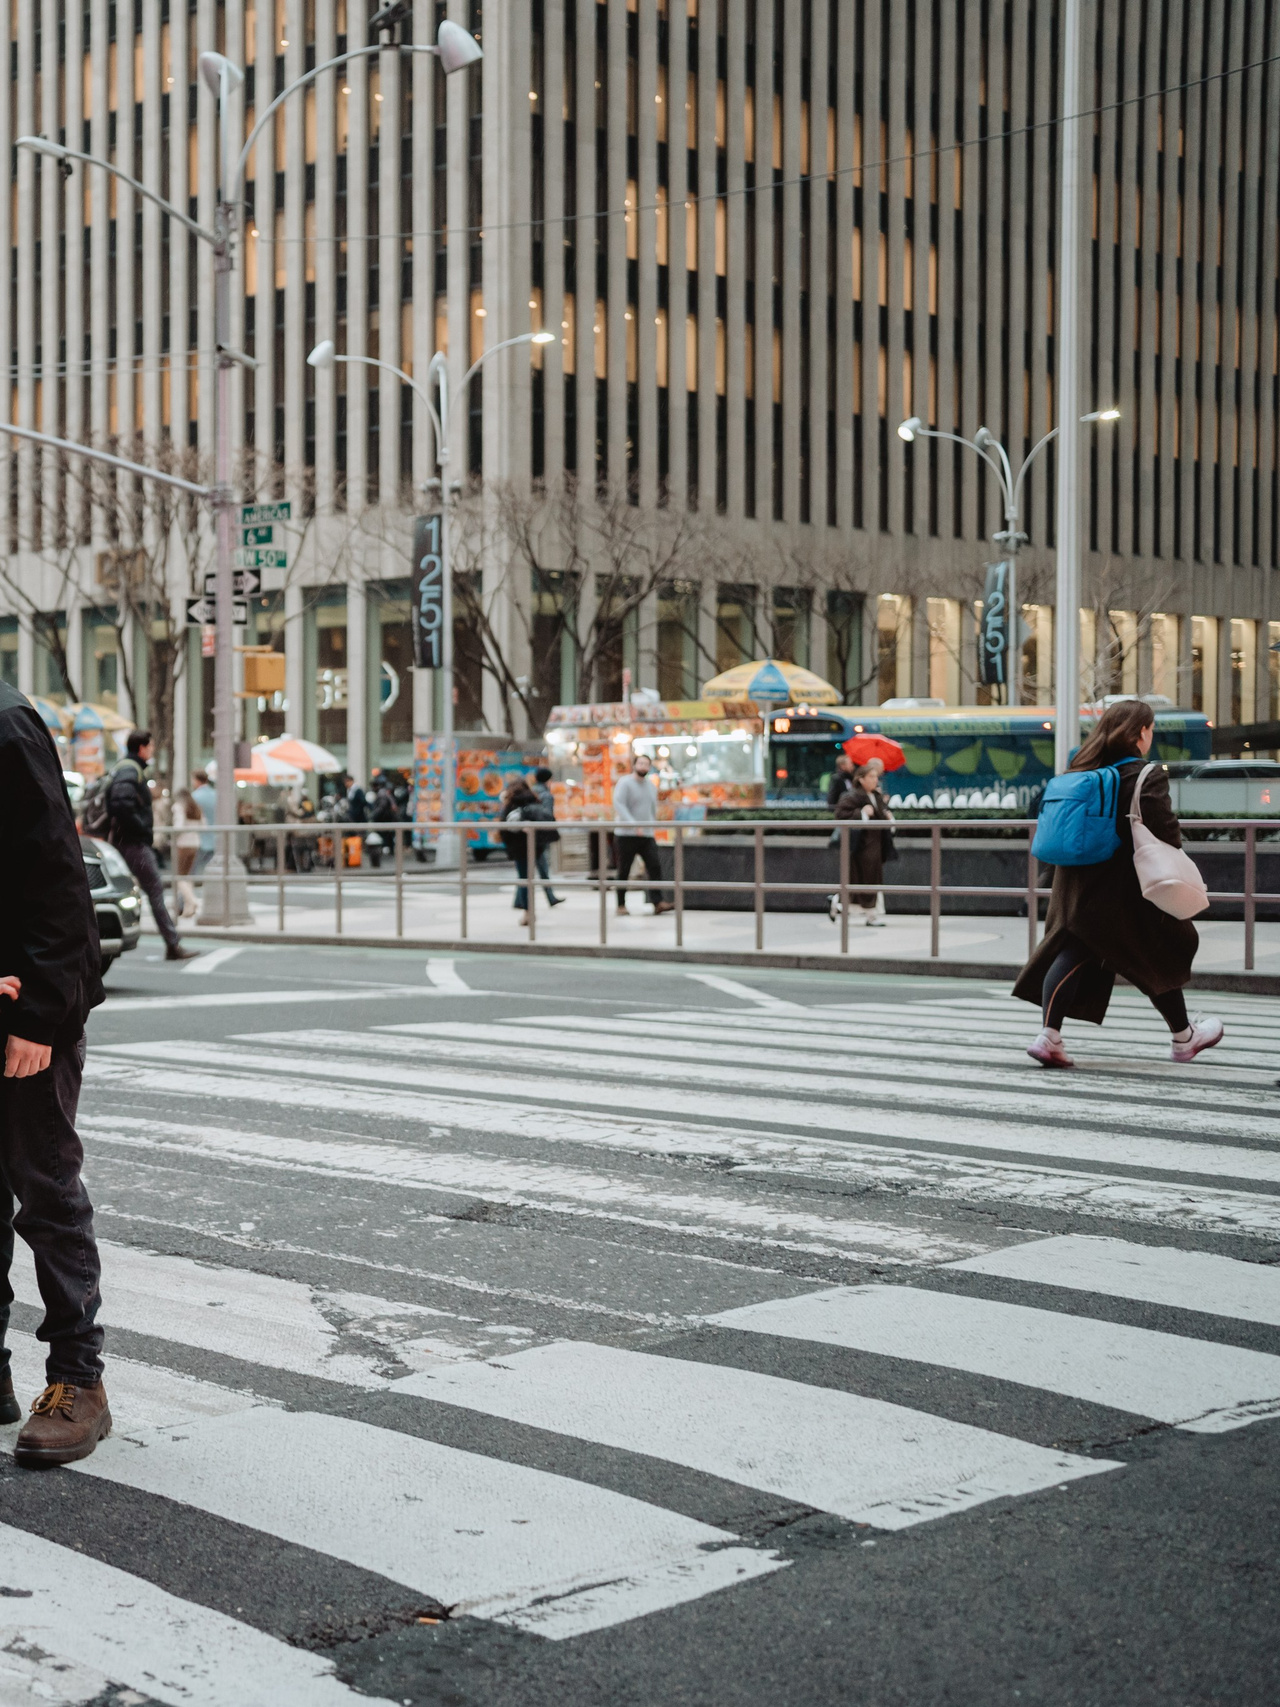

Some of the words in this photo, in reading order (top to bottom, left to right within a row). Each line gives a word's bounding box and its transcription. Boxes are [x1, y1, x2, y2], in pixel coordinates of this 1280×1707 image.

[244, 507, 288, 524] AMERICAS
[246, 529, 257, 546] 6
[244, 549, 255, 566] W
[258, 550, 276, 567] 50
[418, 515, 443, 668] 1251
[984, 561, 1008, 683] 1251
